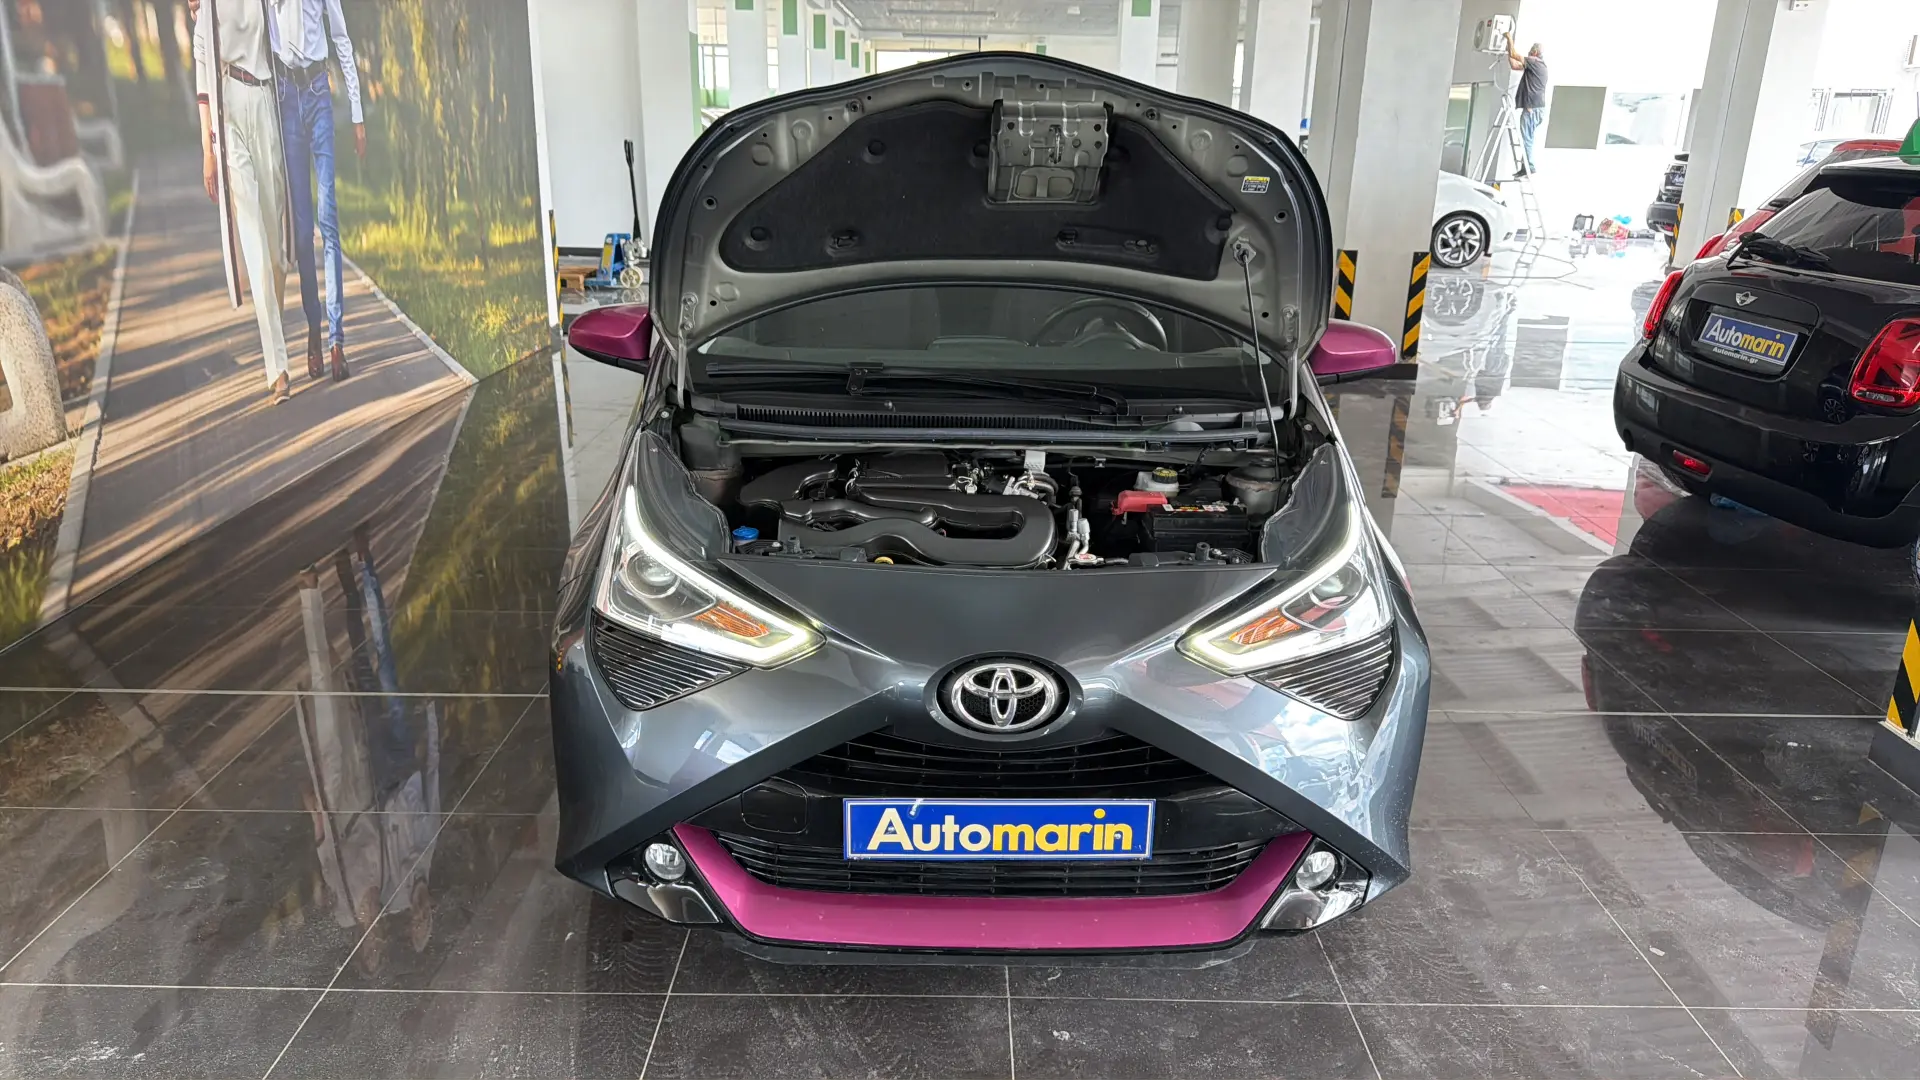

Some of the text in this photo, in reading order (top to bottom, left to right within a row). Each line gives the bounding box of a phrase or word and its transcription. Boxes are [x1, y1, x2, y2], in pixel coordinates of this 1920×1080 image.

[1706, 319, 1785, 358] Automarin
[1713, 346, 1758, 364] Automarin.gr
[866, 808, 1133, 852] Automarin
